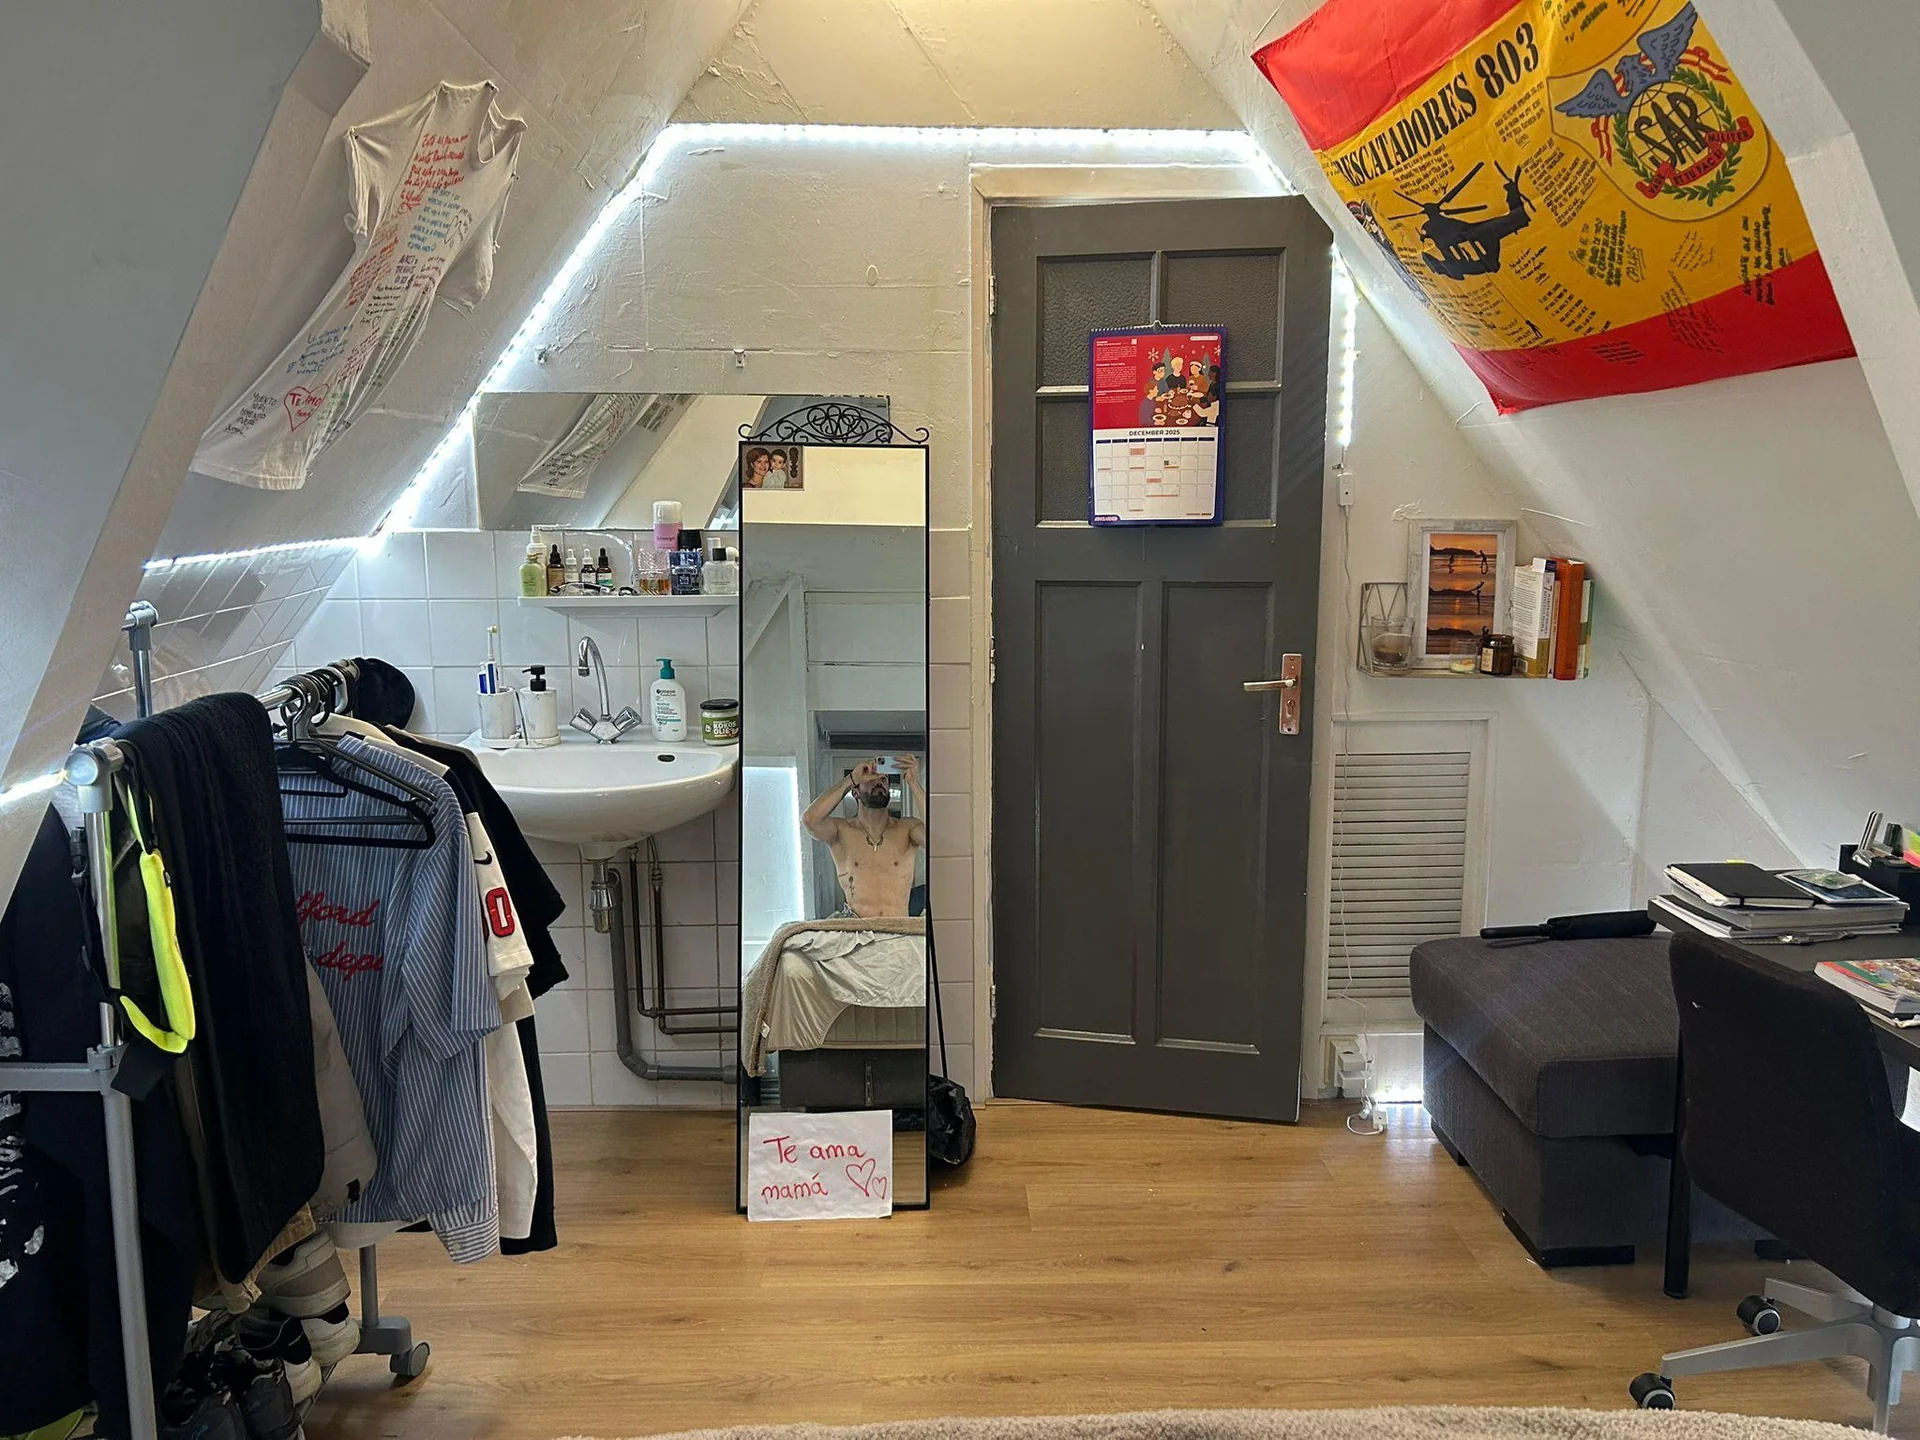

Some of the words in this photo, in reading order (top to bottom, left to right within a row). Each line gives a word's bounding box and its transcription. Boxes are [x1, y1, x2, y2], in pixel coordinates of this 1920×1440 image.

[1475, 21, 1539, 99] 803
[1634, 91, 1717, 171] SAR
[483, 886, 516, 938] 0
[763, 1135, 798, 1164] Te
[809, 1144, 866, 1161] ama
[761, 1172, 828, 1204] mamá
